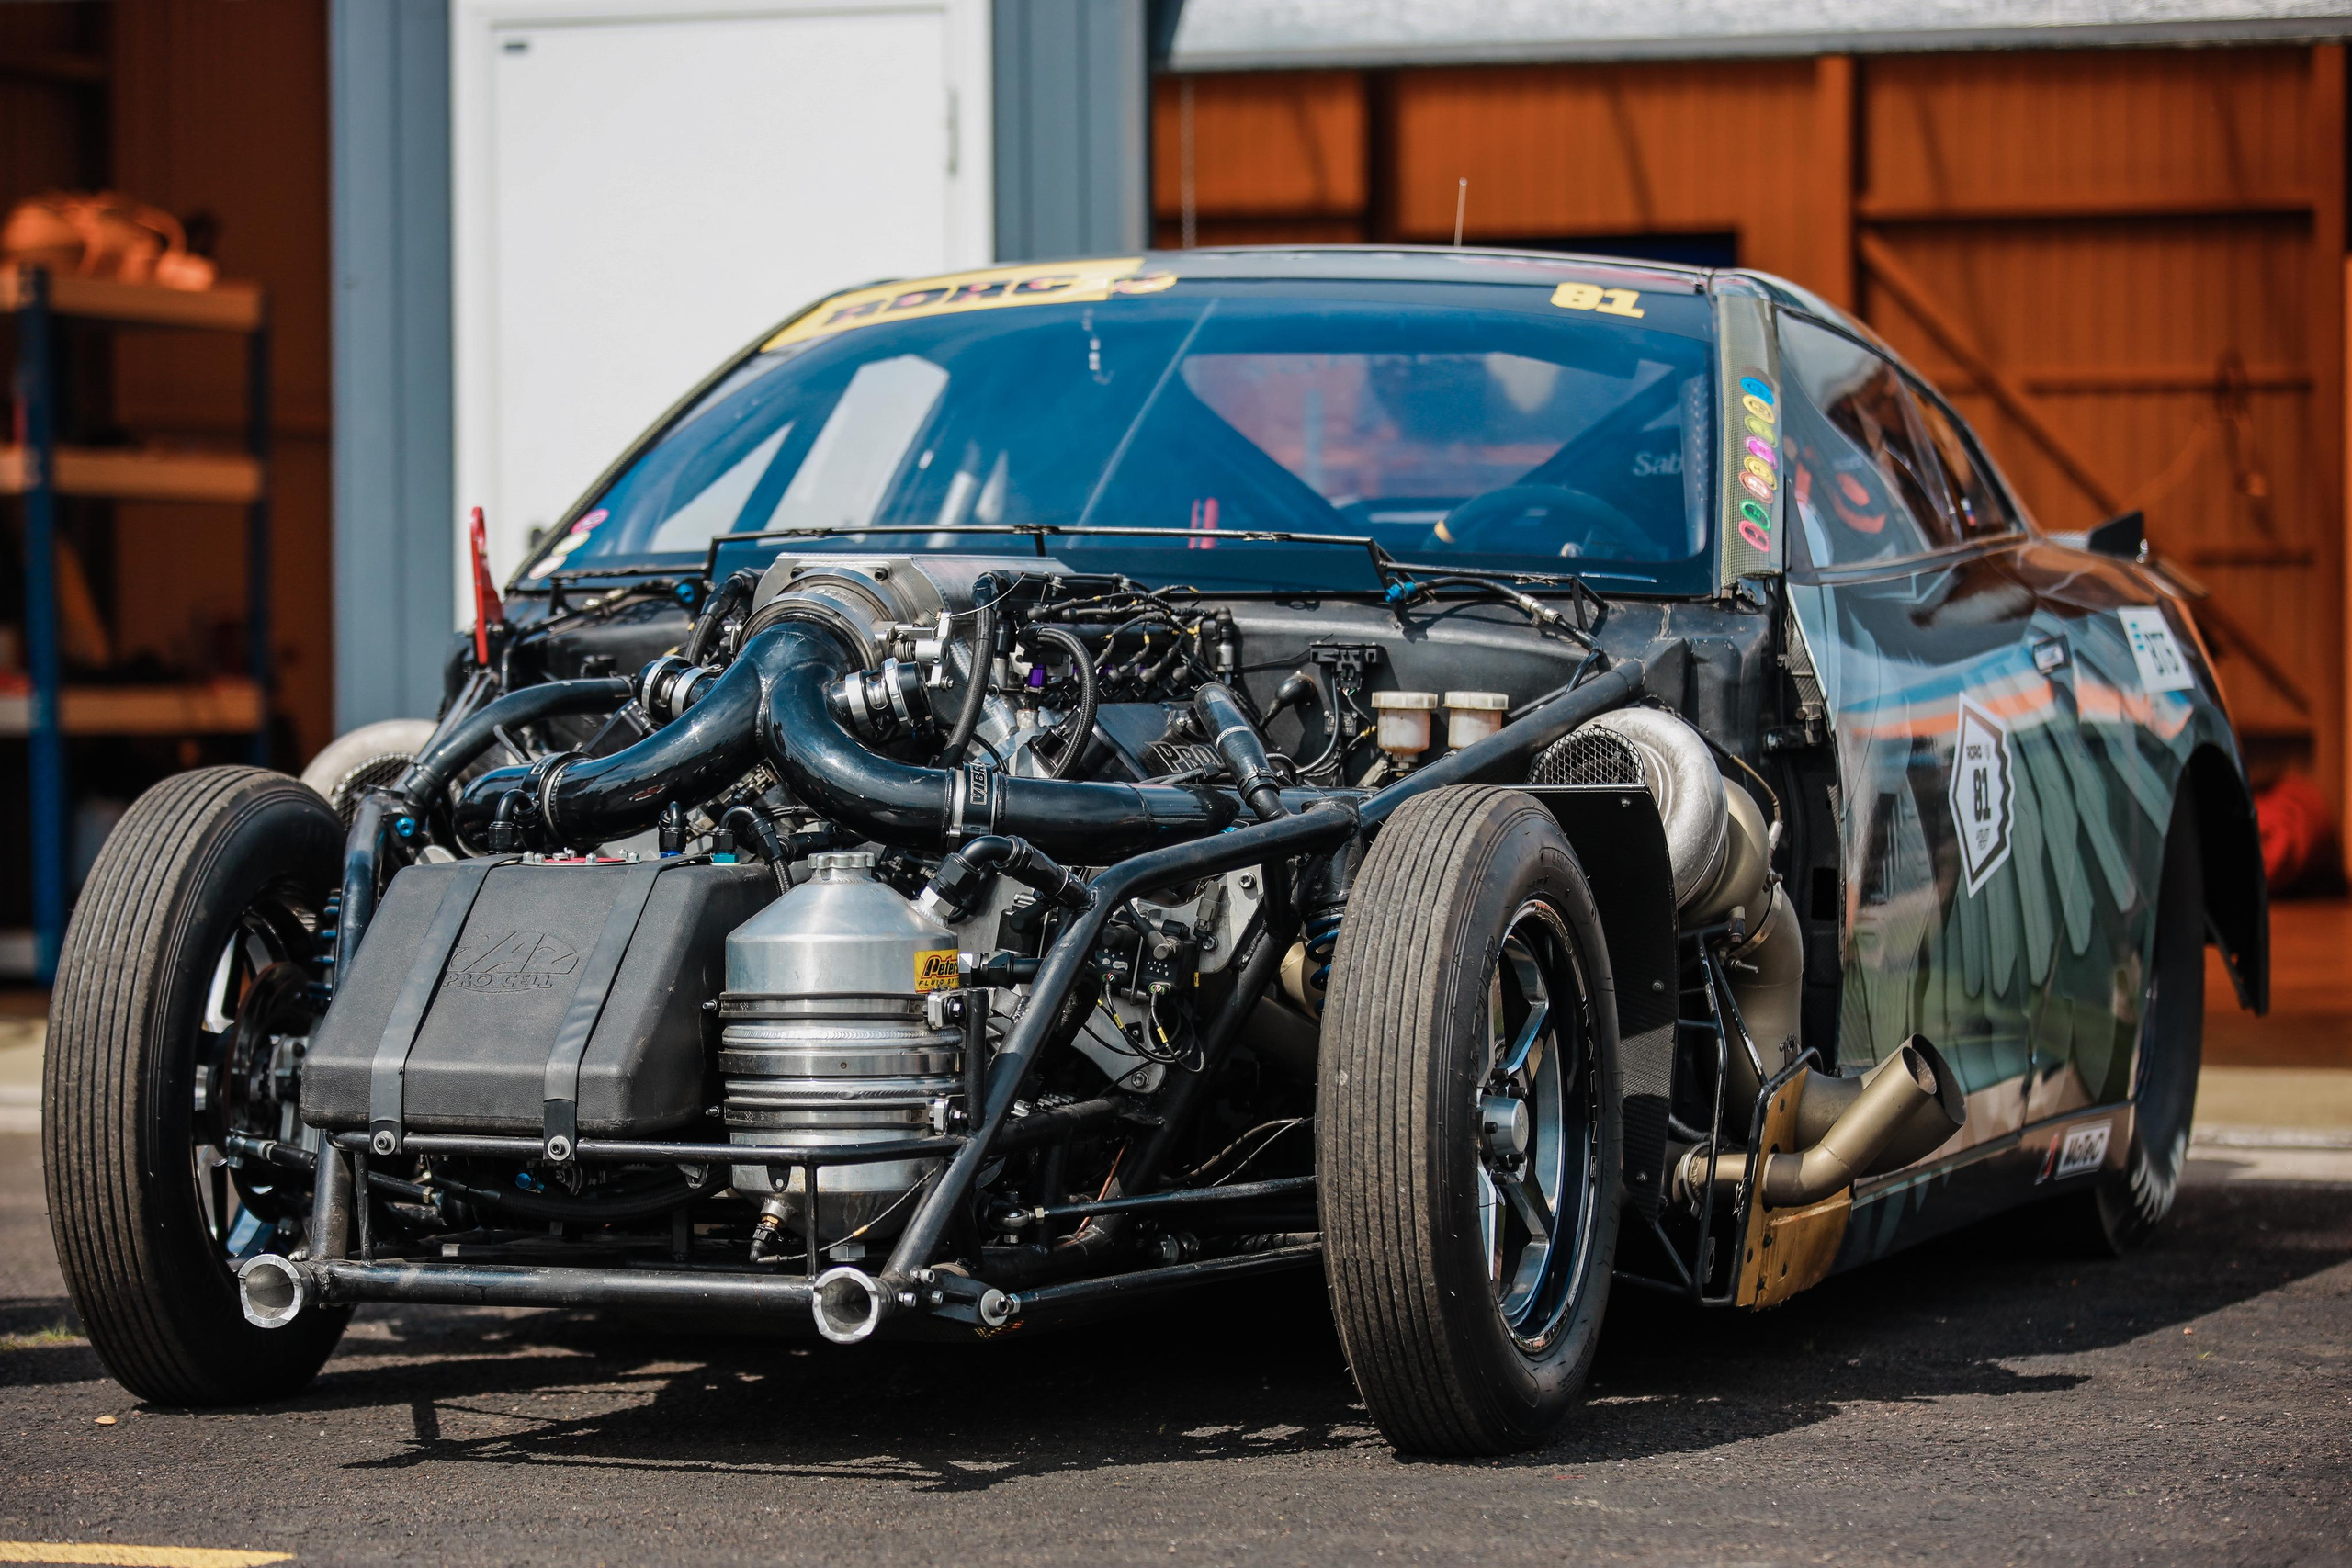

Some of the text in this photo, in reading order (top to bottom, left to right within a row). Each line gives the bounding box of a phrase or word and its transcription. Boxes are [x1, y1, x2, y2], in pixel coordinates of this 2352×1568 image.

[1550, 281, 1645, 319] 81
[1633, 451, 1683, 477] Sab
[970, 762, 988, 806] VIBR
[1973, 767, 1991, 823] 81
[444, 973, 553, 989] PRO CELL
[922, 956, 959, 977] Peter
